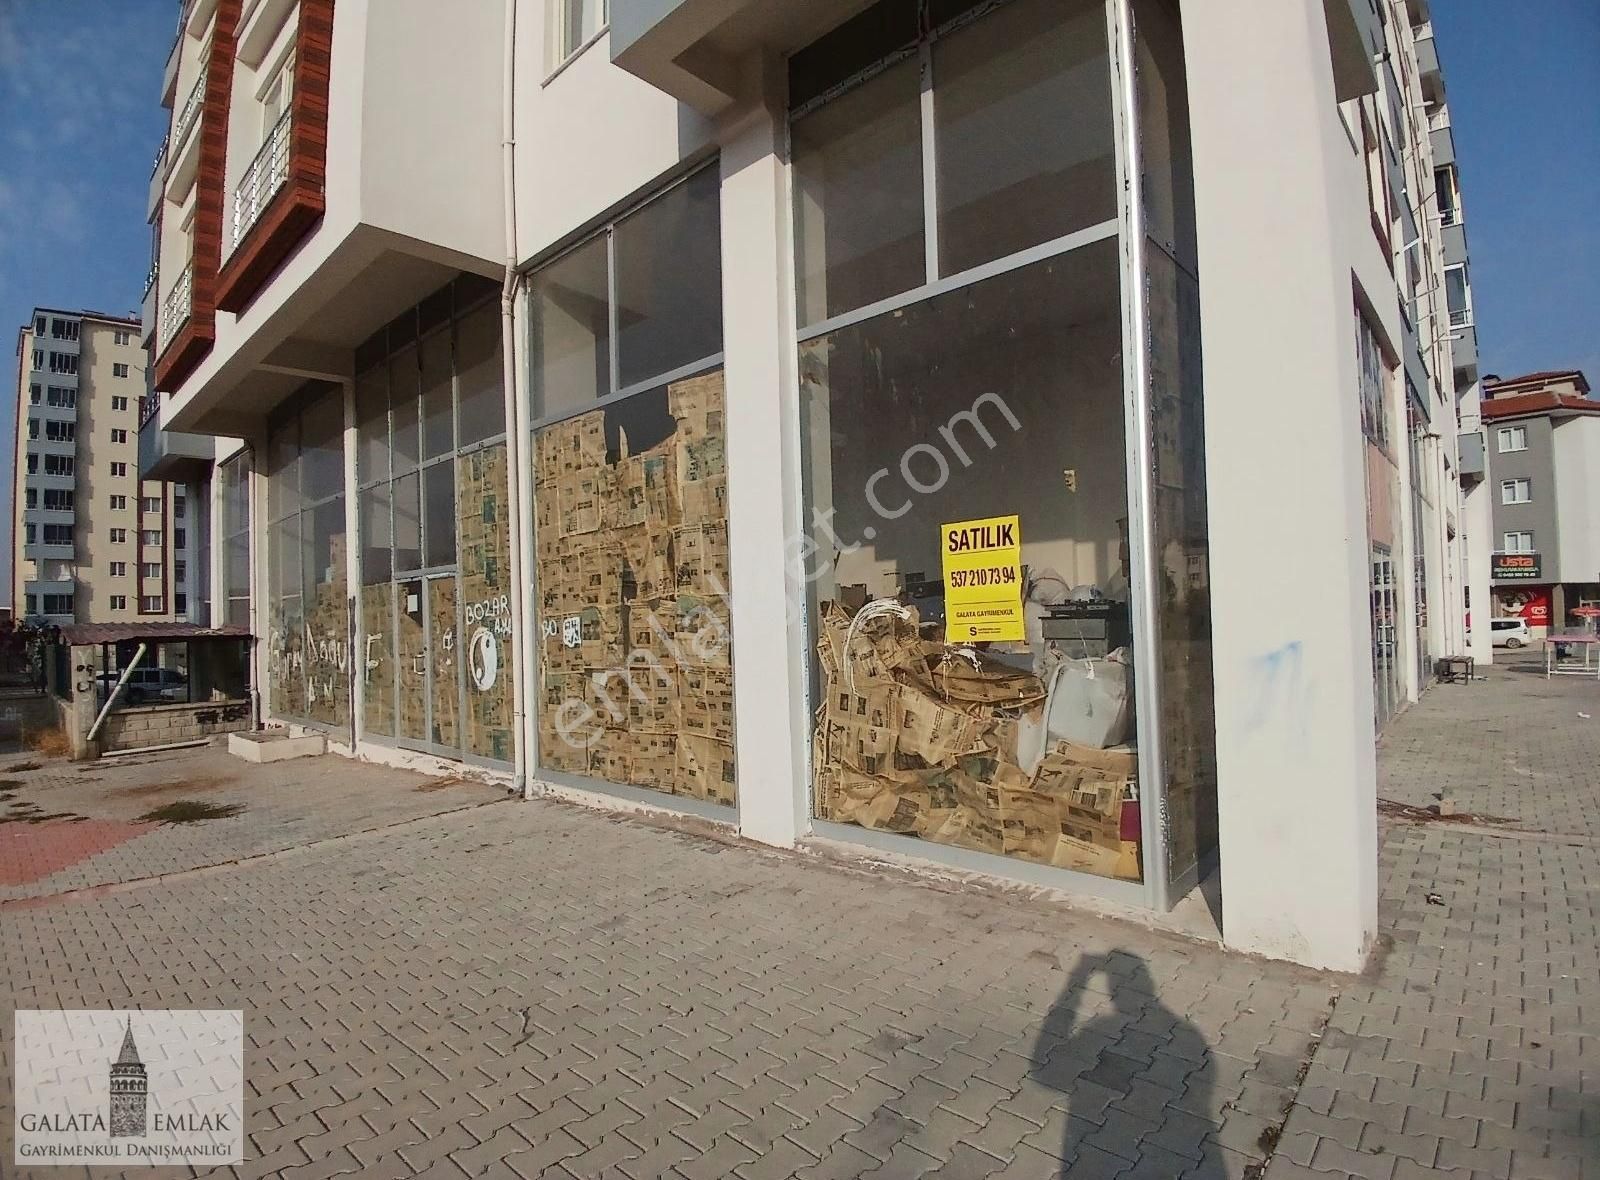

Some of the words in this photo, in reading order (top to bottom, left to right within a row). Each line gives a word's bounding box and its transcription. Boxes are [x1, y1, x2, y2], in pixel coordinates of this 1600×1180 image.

[948, 523, 1014, 552] SATILIK
[951, 570, 967, 588] 537
[969, 568, 986, 586] 210
[988, 566, 1001, 585] 73
[1002, 565, 1016, 584] 94
